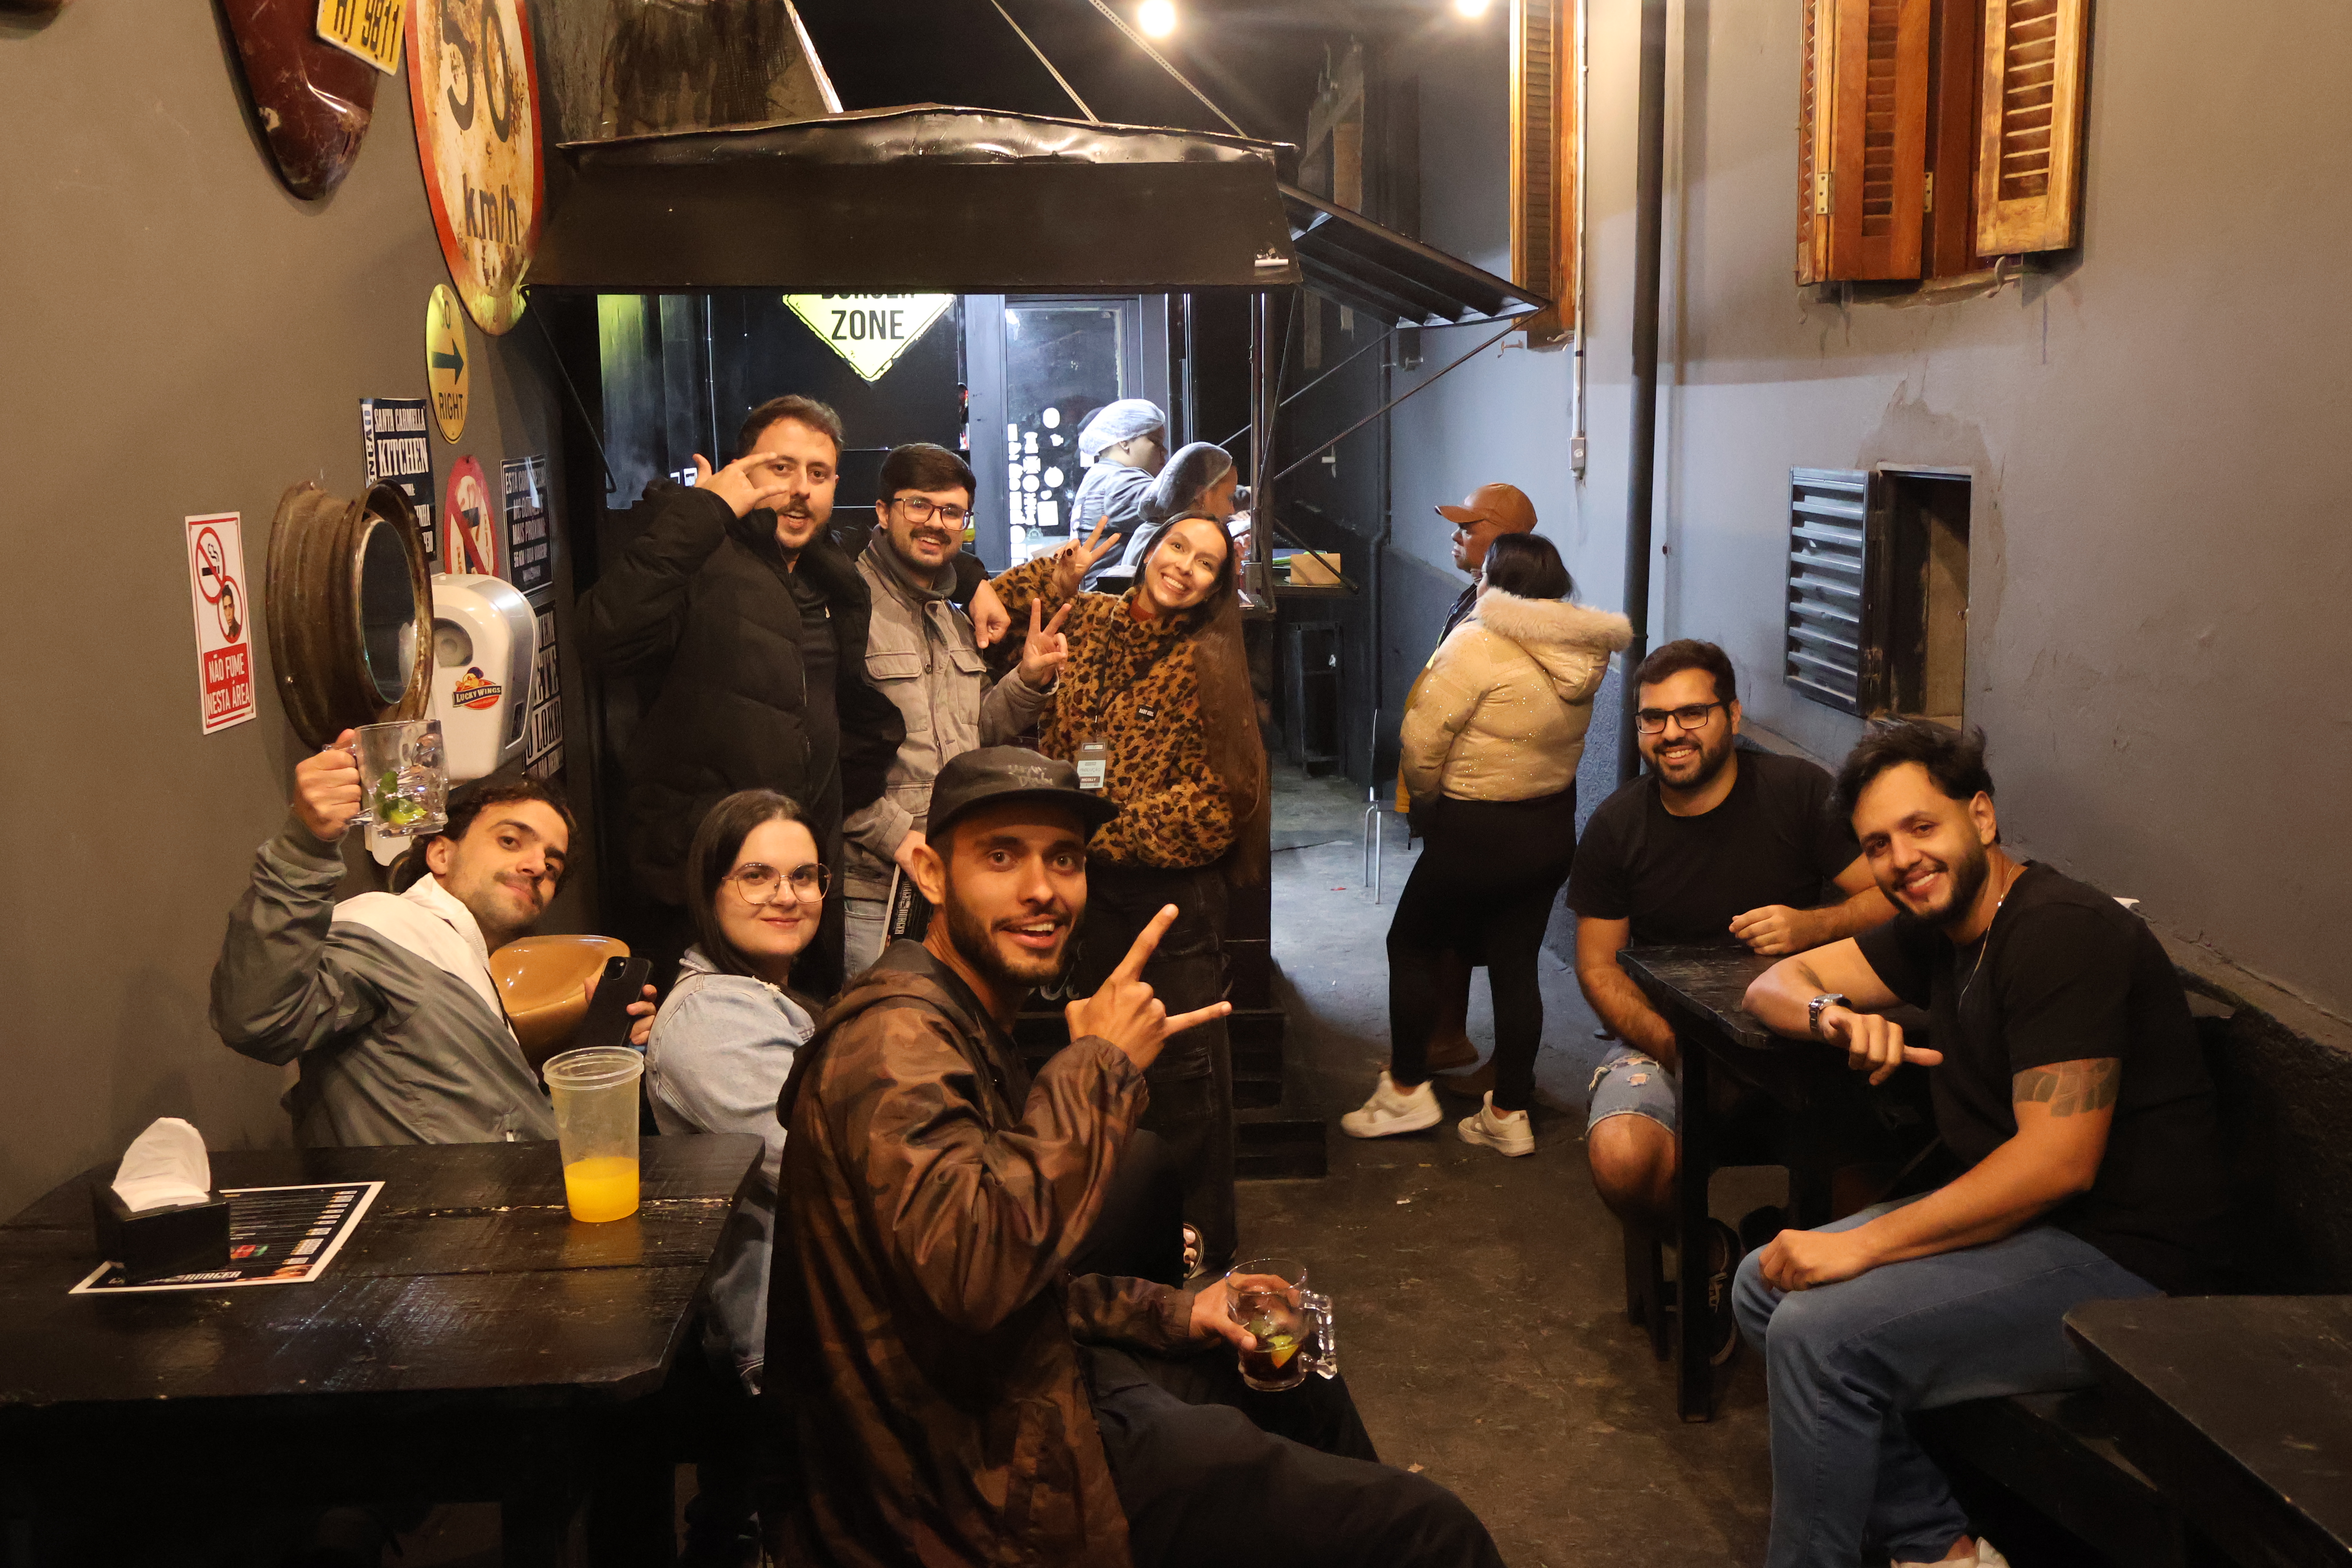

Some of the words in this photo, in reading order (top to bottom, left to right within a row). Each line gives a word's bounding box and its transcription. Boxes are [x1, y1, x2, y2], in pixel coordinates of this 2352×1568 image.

[441, 0, 511, 143] 50
[462, 172, 519, 245] km/h
[831, 310, 904, 340] ZONE
[374, 408, 395, 432] SANTA
[438, 392, 463, 421] RIGHT
[377, 437, 429, 477] KITCHEN
[208, 653, 225, 683] NÃO
[225, 653, 245, 679] FUME
[207, 688, 232, 716] NESTA
[232, 680, 251, 708] ÁREA
[456, 690, 477, 703] LUCKY
[477, 687, 501, 697] WINGS
[535, 701, 561, 753] LOKO
